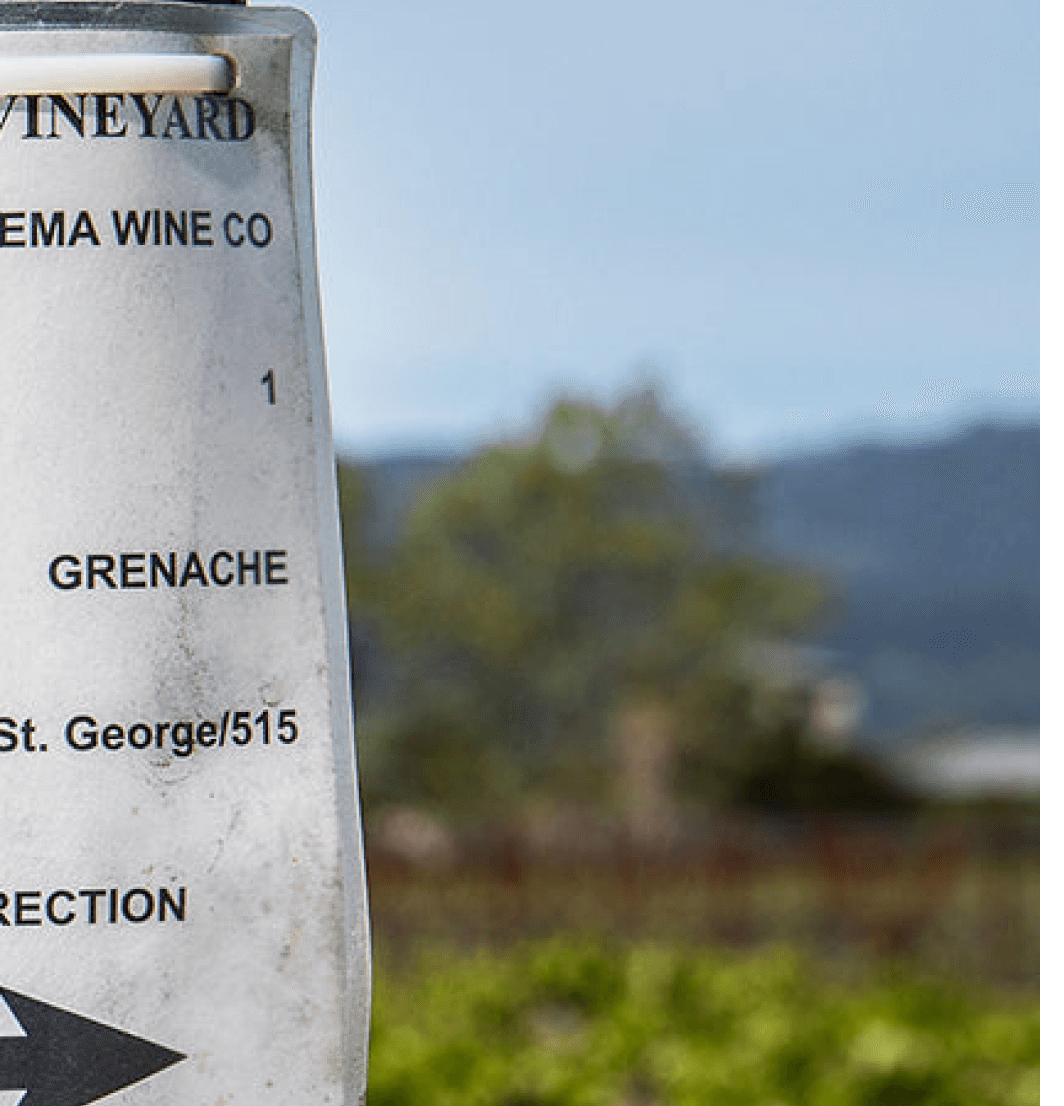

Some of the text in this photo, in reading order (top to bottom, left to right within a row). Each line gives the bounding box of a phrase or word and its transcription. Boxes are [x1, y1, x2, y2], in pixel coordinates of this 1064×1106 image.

[112, 209, 215, 247] WINE
[222, 210, 273, 249] CO
[259, 369, 277, 407] 1
[48, 549, 290, 591] GRENACHE
[65, 708, 299, 759] George/515
